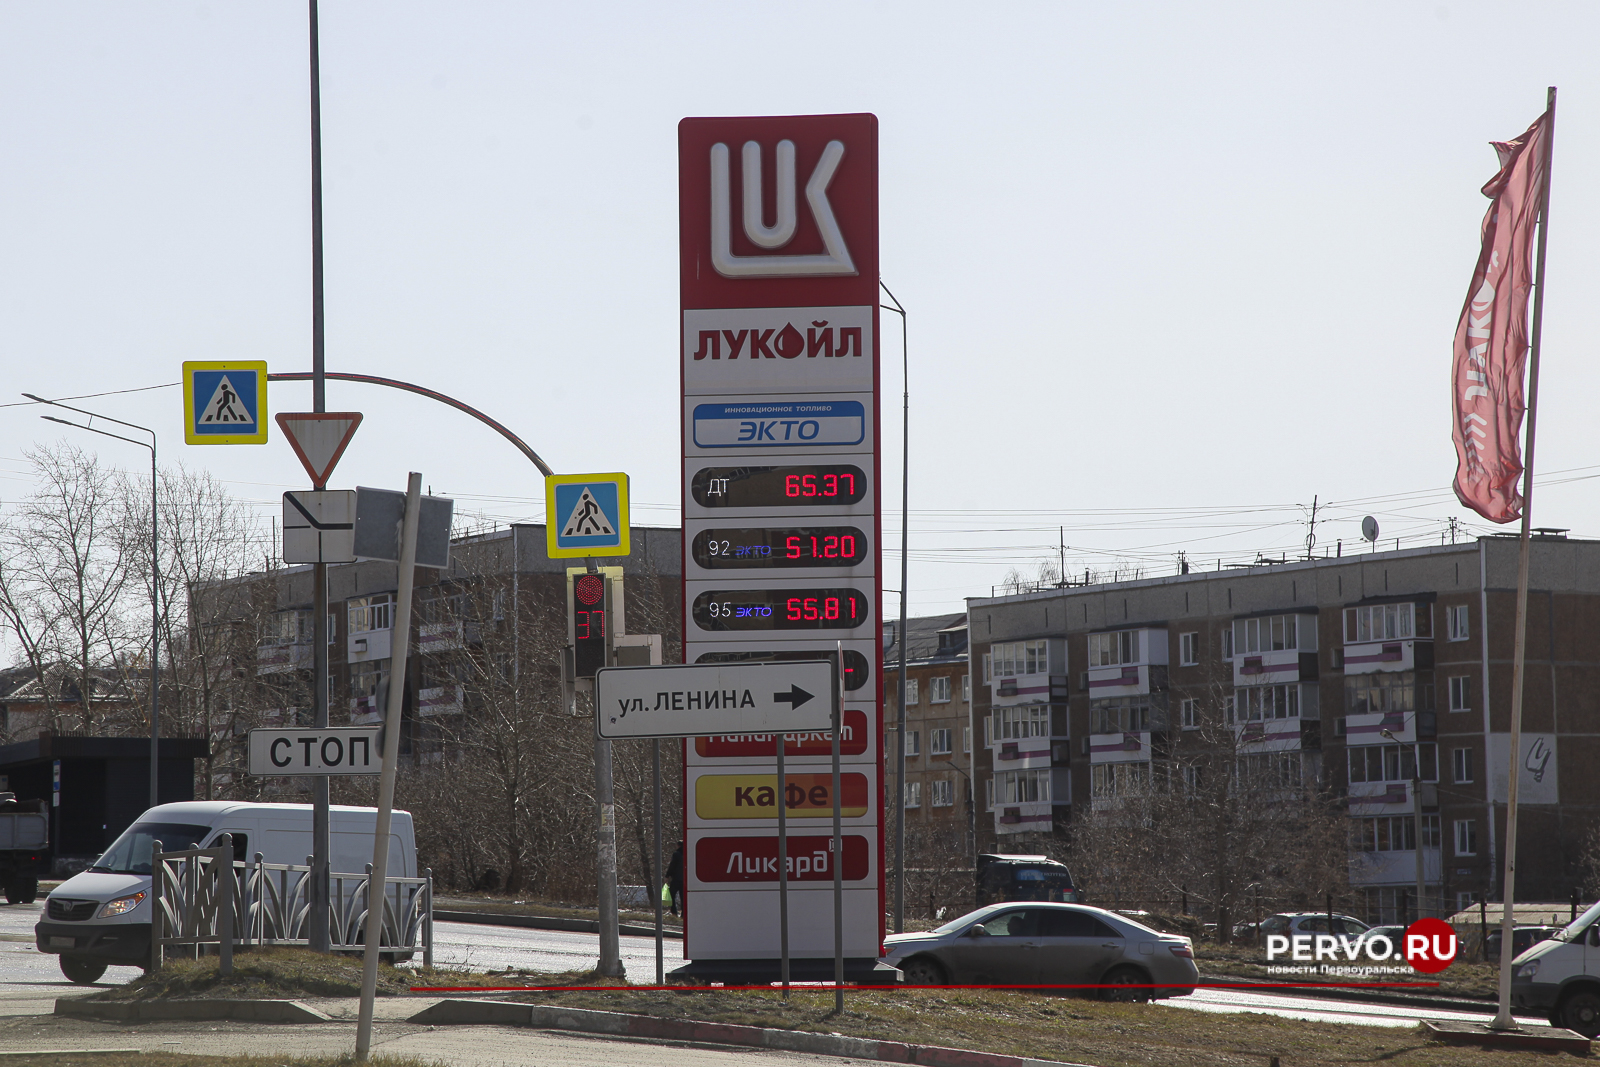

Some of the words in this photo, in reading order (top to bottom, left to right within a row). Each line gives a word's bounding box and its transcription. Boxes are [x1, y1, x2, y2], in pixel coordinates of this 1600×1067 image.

[693, 319, 862, 360] ЛУКОЙЛ
[724, 406, 793, 414] ИННОВАЦИОННОЕ
[737, 420, 820, 441] ЭКТО
[707, 478, 730, 497] ДТ
[785, 473, 855, 497] 65.37
[709, 540, 730, 556] 92
[735, 545, 772, 556] ЭКТО
[786, 535, 856, 559] 51.20
[709, 602, 732, 617] 95
[735, 606, 773, 617] ЭКТО
[786, 597, 857, 620] 55.81
[577, 610, 605, 639] 37
[269, 736, 370, 768] СТОП
[735, 782, 829, 809] кафе
[726, 851, 828, 878] Ликард
